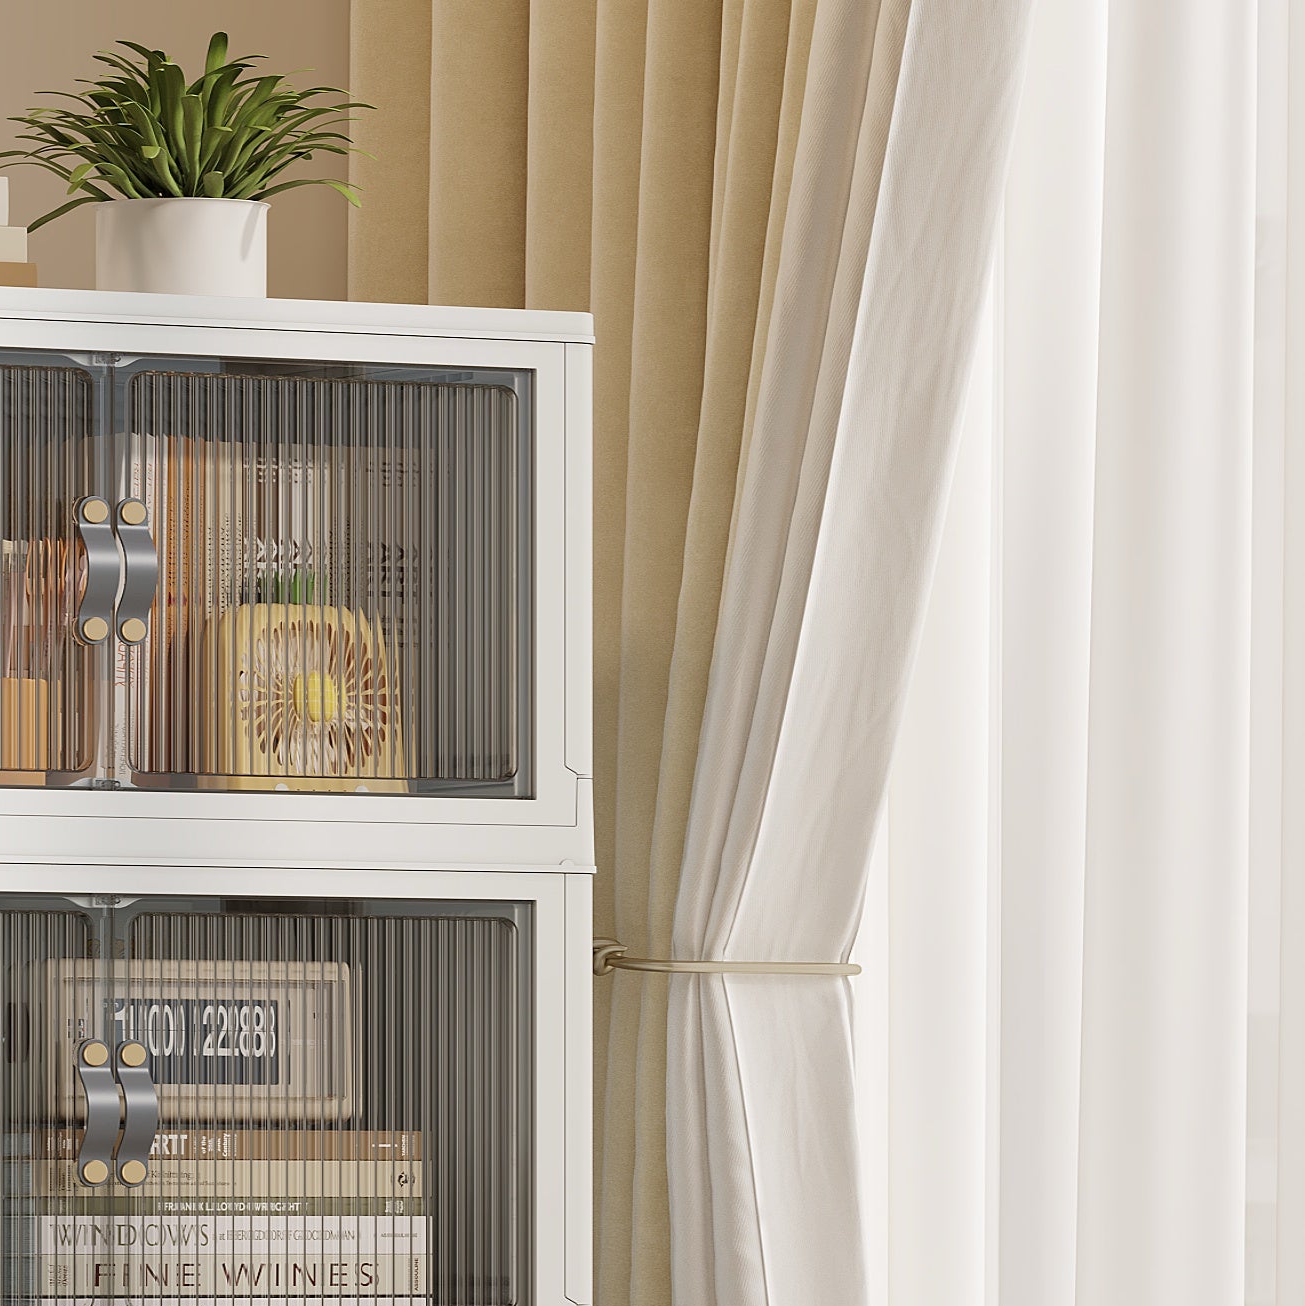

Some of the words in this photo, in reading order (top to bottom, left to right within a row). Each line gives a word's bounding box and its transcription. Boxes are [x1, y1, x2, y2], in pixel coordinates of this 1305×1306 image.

[51, 1224, 209, 1246] WINDOWS
[92, 1264, 201, 1287] FINE
[222, 1263, 379, 1287] WINES
